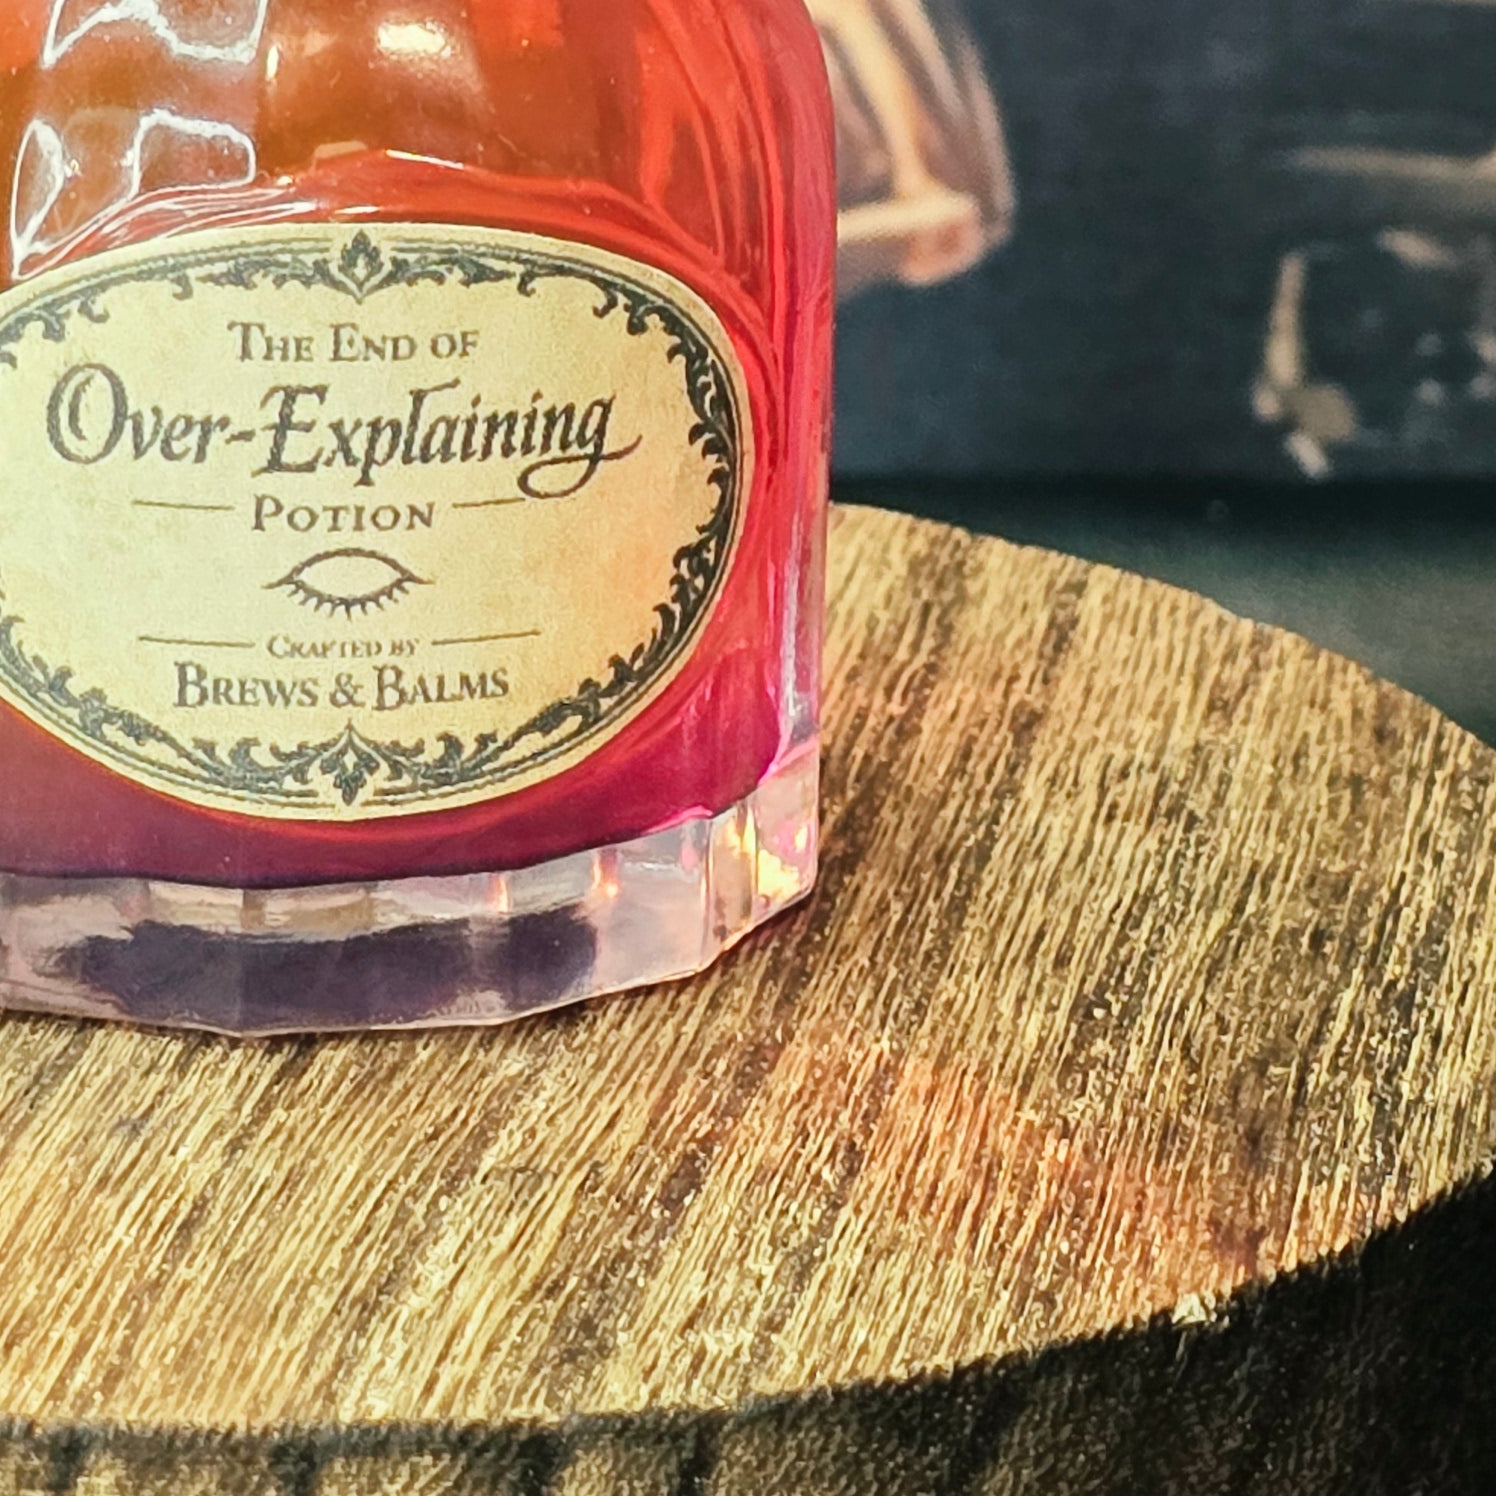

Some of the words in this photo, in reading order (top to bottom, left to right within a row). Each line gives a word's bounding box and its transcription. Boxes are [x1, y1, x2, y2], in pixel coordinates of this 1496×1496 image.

[46, 362, 643, 500] Over-Explaining
[253, 495, 435, 533] POTION
[174, 661, 318, 708] BREWS
[328, 673, 365, 706] &
[372, 665, 509, 711] BALMS
